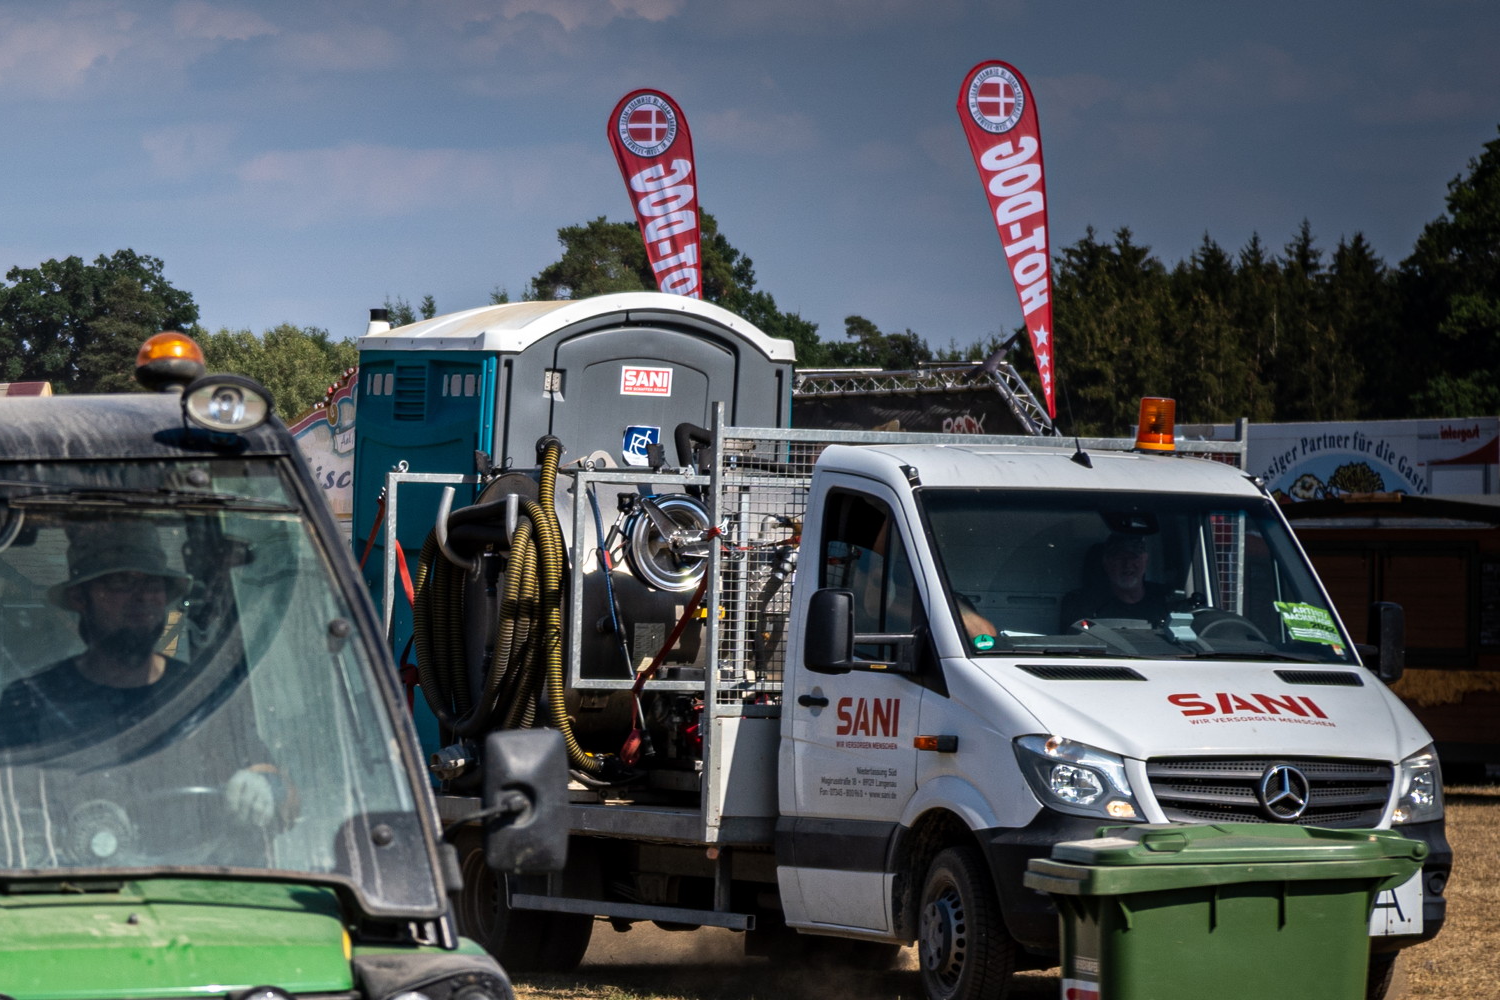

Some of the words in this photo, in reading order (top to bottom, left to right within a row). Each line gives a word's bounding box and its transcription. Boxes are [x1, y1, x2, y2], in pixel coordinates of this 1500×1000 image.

[625, 370, 669, 387] SANI
[1258, 446, 1298, 485] ssiger
[1301, 433, 1350, 456] Partner
[1352, 430, 1373, 453] für
[1375, 440, 1396, 465] die
[315, 464, 353, 490] isc
[837, 697, 901, 737] SANI
[1167, 692, 1329, 719] SANI
[1213, 716, 1277, 724] VERSORGEN
[1278, 717, 1337, 728] MENSCHEN
